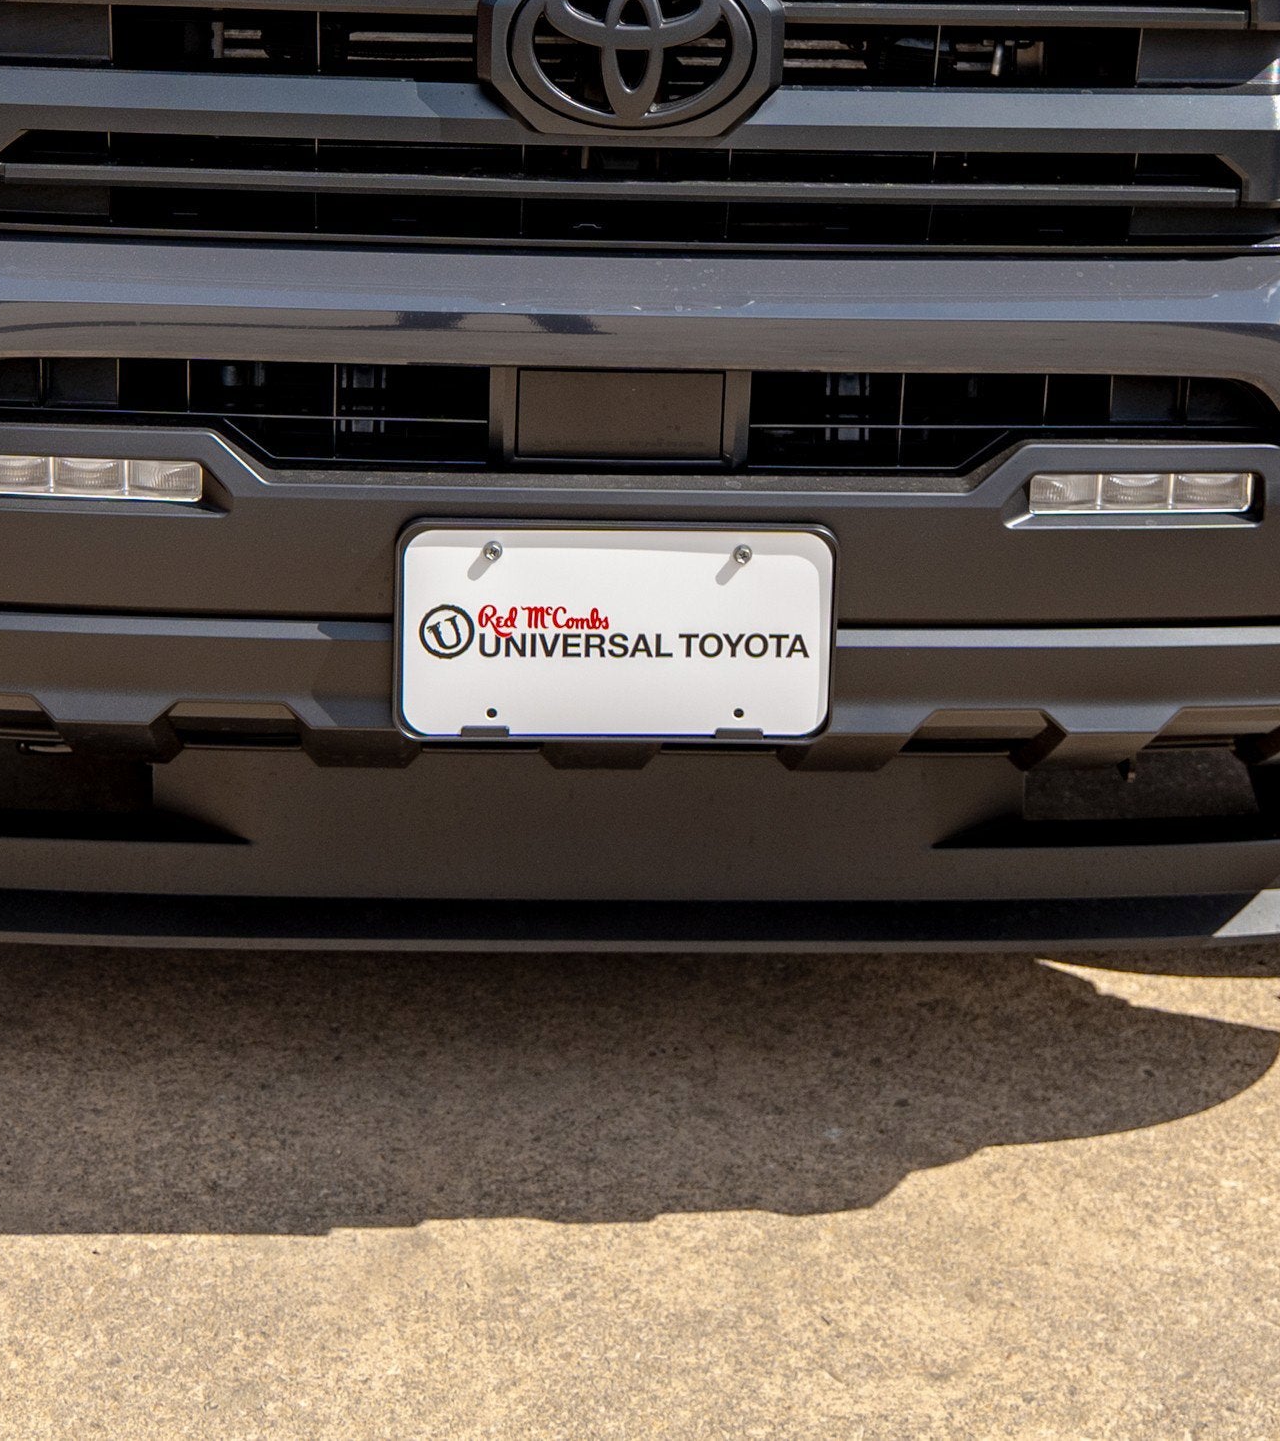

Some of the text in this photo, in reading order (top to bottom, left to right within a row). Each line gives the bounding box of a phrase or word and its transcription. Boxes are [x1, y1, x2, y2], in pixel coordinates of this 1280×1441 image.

[477, 604, 610, 640] Red McCombs
[478, 632, 810, 659] UNIVERSAL TOYOTA
